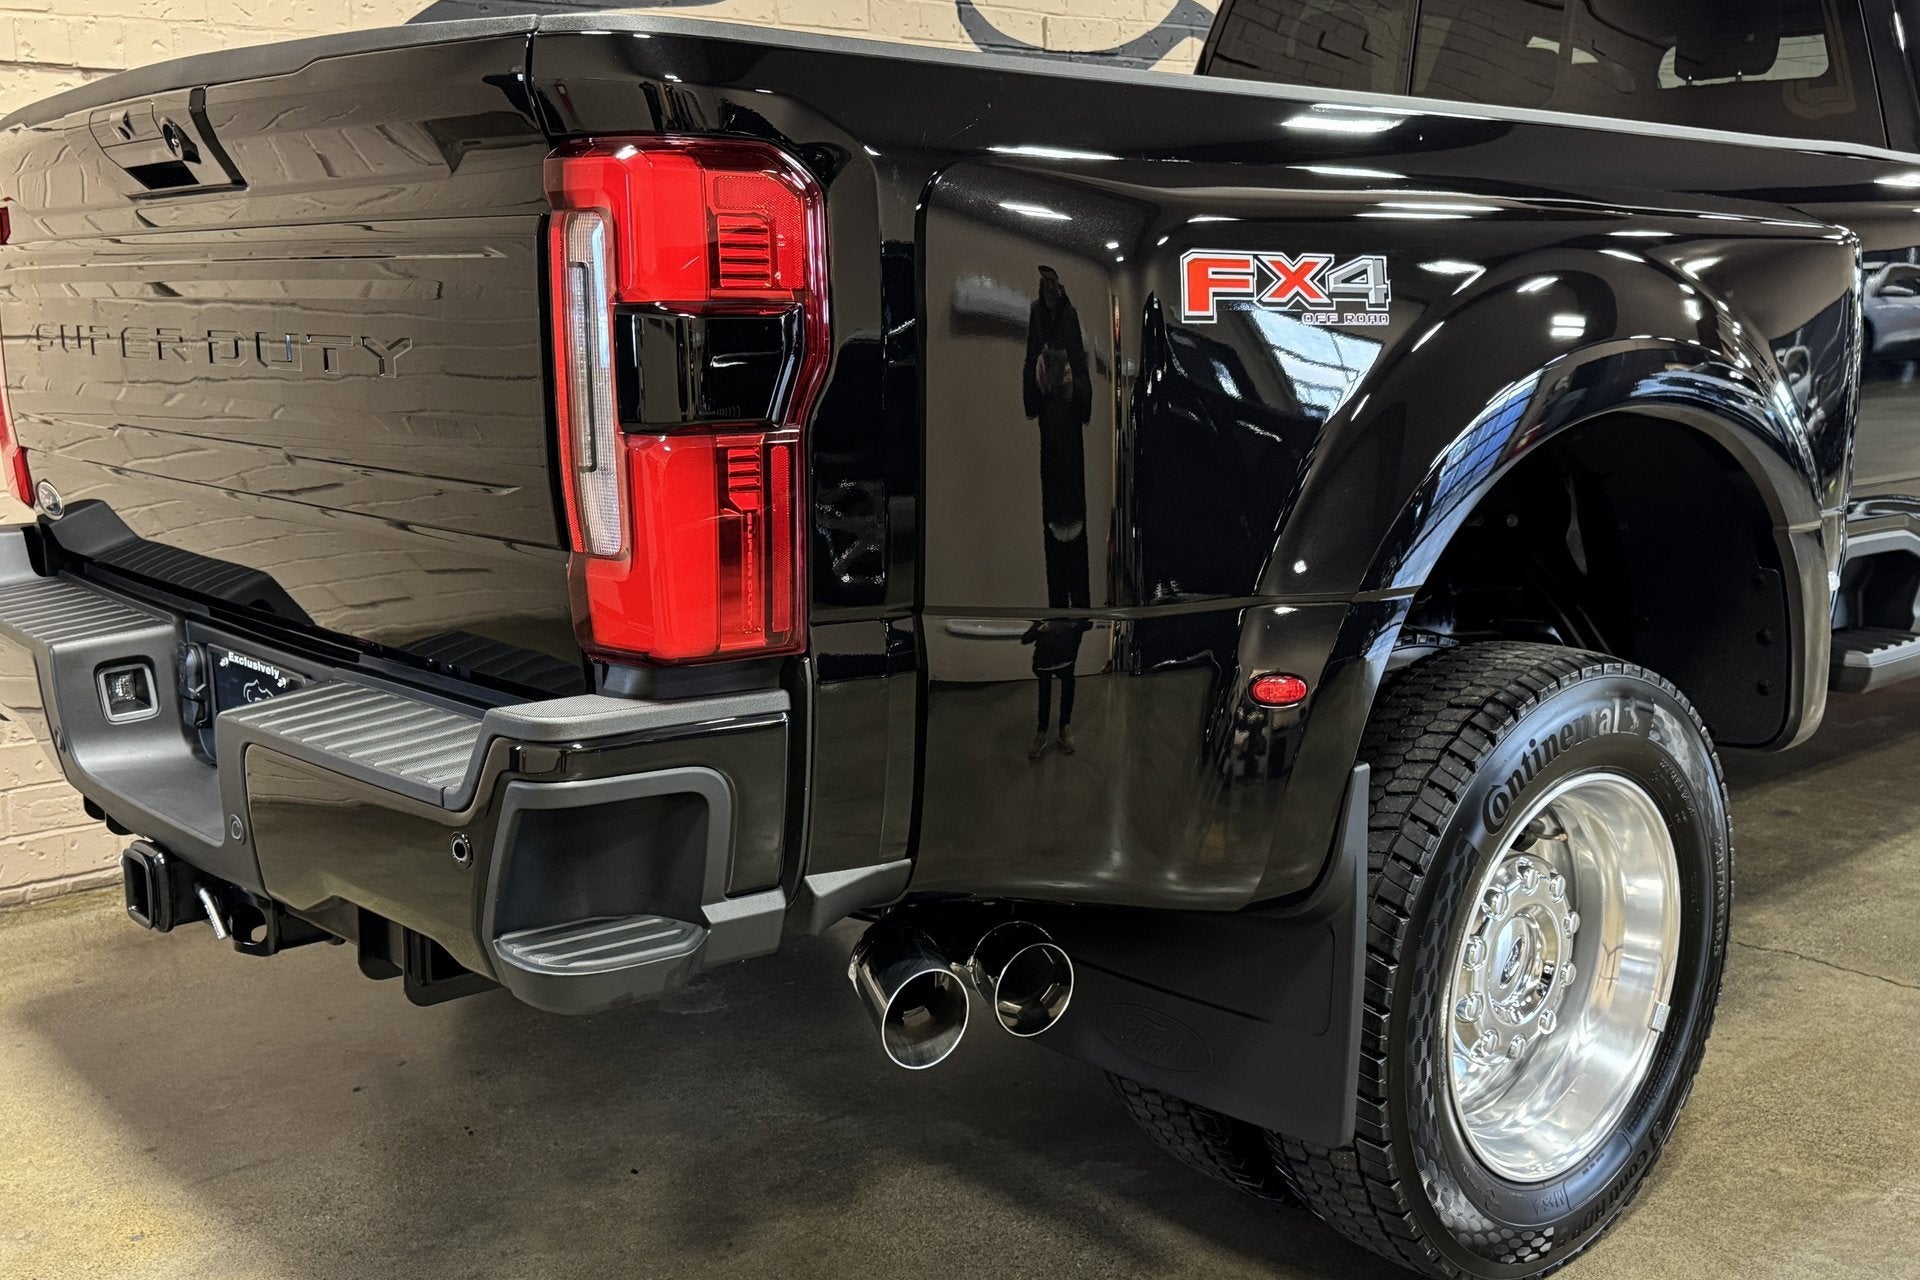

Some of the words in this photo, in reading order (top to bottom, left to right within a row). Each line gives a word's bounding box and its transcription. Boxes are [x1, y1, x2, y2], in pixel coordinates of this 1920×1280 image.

[1181, 248, 1391, 324] FX4
[1302, 313, 1338, 325] OFF
[1345, 313, 1389, 325] ROAD
[36, 323, 191, 362] SUPER
[207, 329, 412, 379] DUTY
[228, 651, 280, 679] Exclusively
[1482, 698, 1620, 835] Continental
